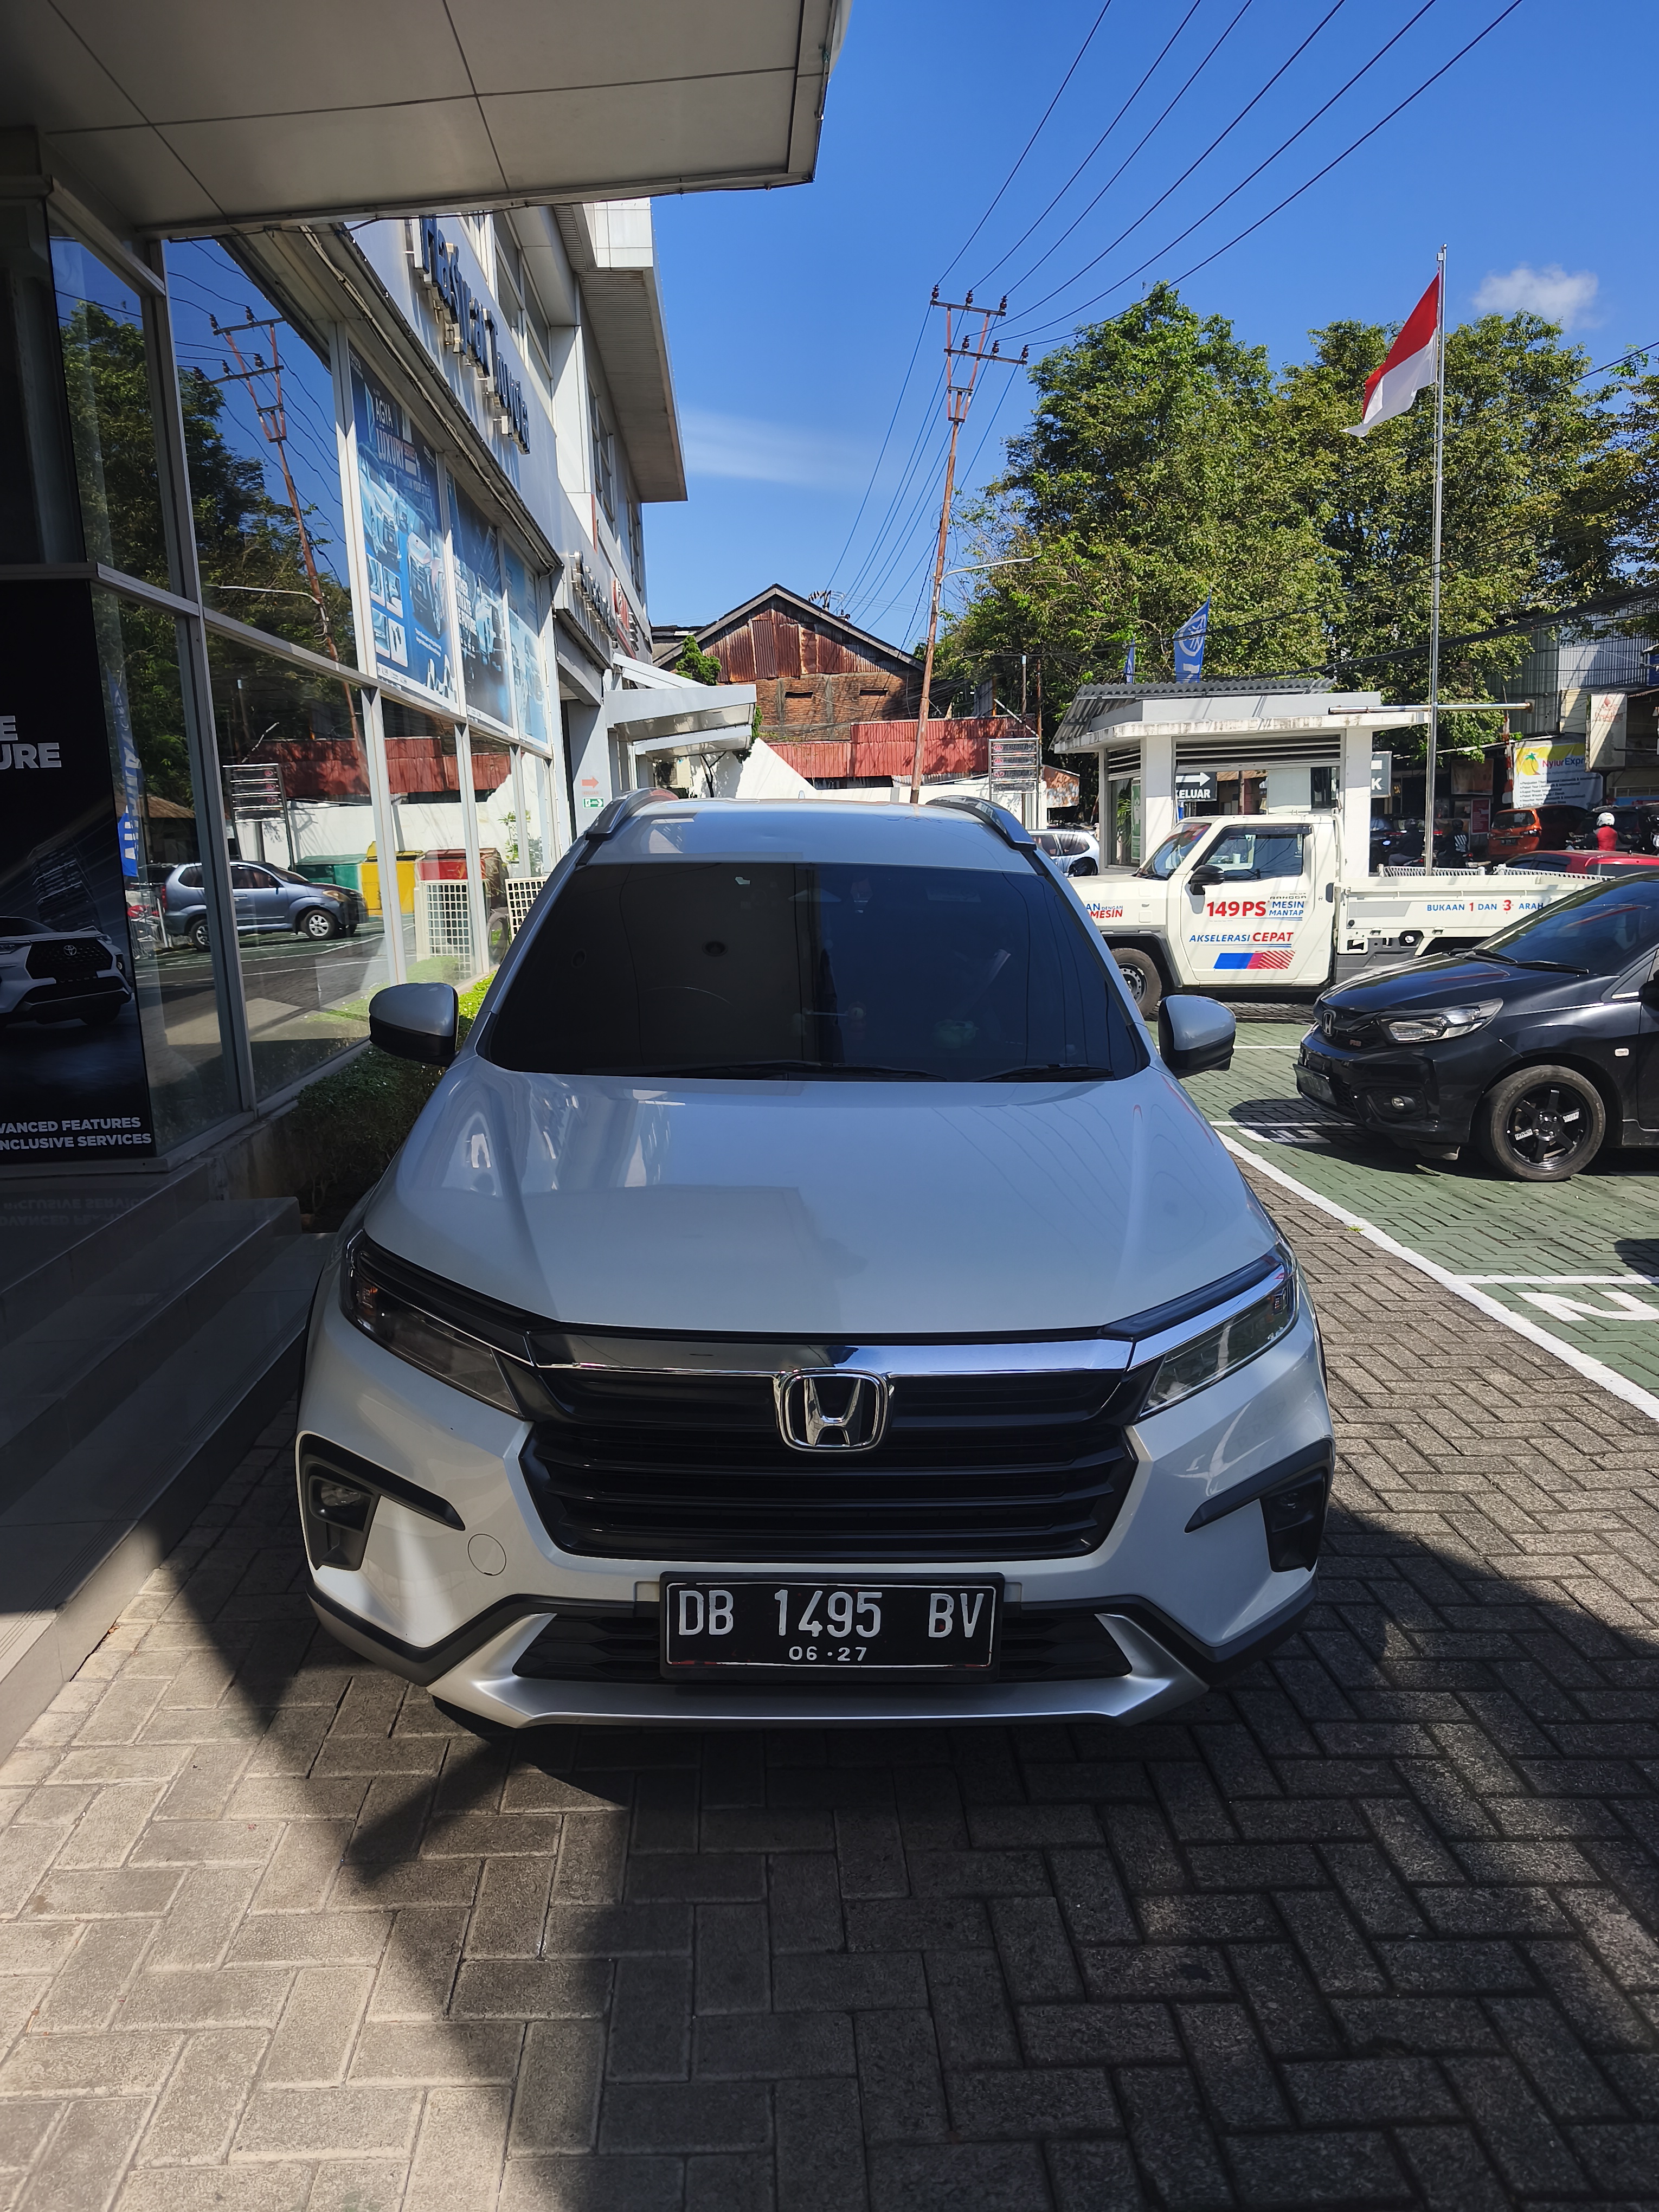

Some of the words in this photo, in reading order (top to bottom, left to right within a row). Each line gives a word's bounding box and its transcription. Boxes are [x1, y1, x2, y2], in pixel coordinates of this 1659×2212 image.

[375, 397, 393, 428] AGYA
[376, 427, 404, 471] LUXURY
[1272, 901, 1304, 909] MESIN
[1469, 902, 1474, 911] 1
[1503, 899, 1512, 911] 3
[1090, 909, 1123, 918] MESIN
[1189, 934, 1250, 942] AKSELERASI
[1252, 932, 1294, 942] CEPAT
[61, 1117, 141, 1131] FEATURES
[78, 1133, 152, 1147] SERVICES
[678, 1590, 734, 1636] DB
[774, 1589, 883, 1638] 1495
[928, 1592, 985, 1638] BV
